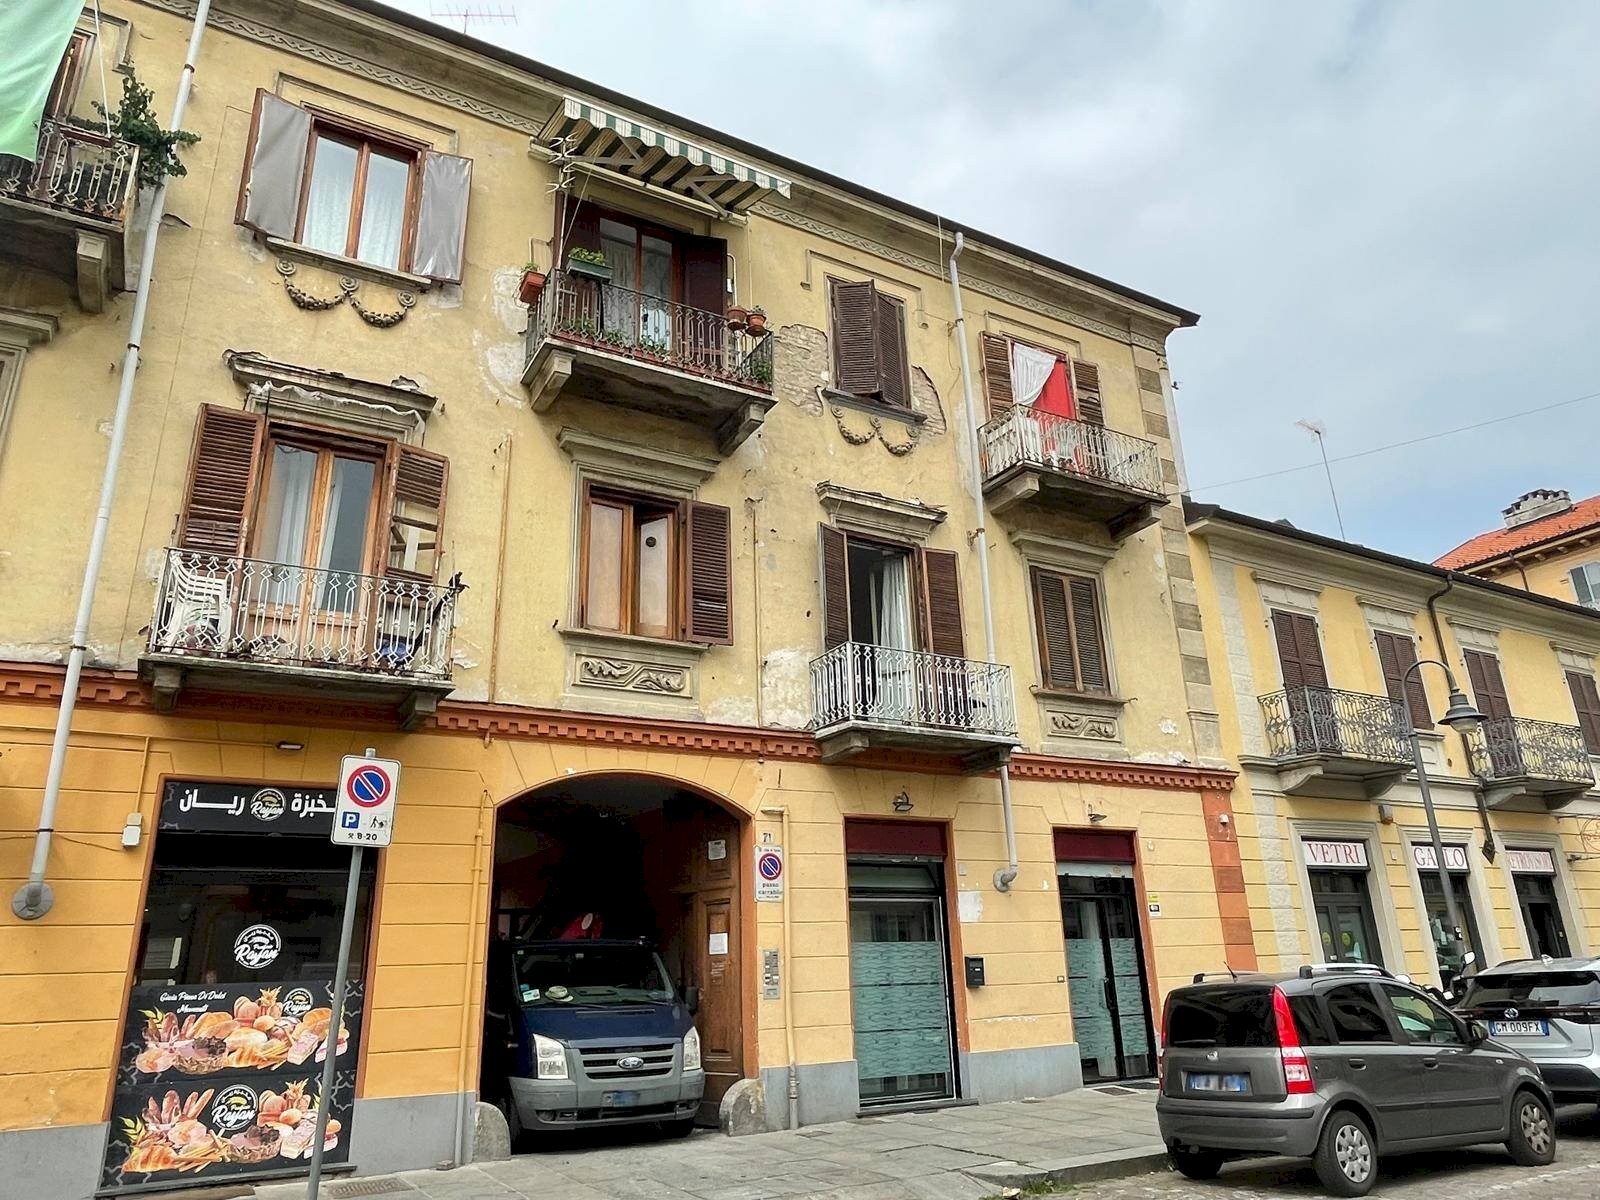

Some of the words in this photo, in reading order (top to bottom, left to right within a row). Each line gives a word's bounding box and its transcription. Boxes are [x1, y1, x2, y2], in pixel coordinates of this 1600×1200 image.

[291, 793, 337, 817] خبزة
[346, 813, 357, 826] P
[1307, 843, 1361, 863] VETRI
[1413, 847, 1465, 867] GALO
[234, 943, 279, 965] Rayan
[211, 1104, 256, 1127] Rayan
